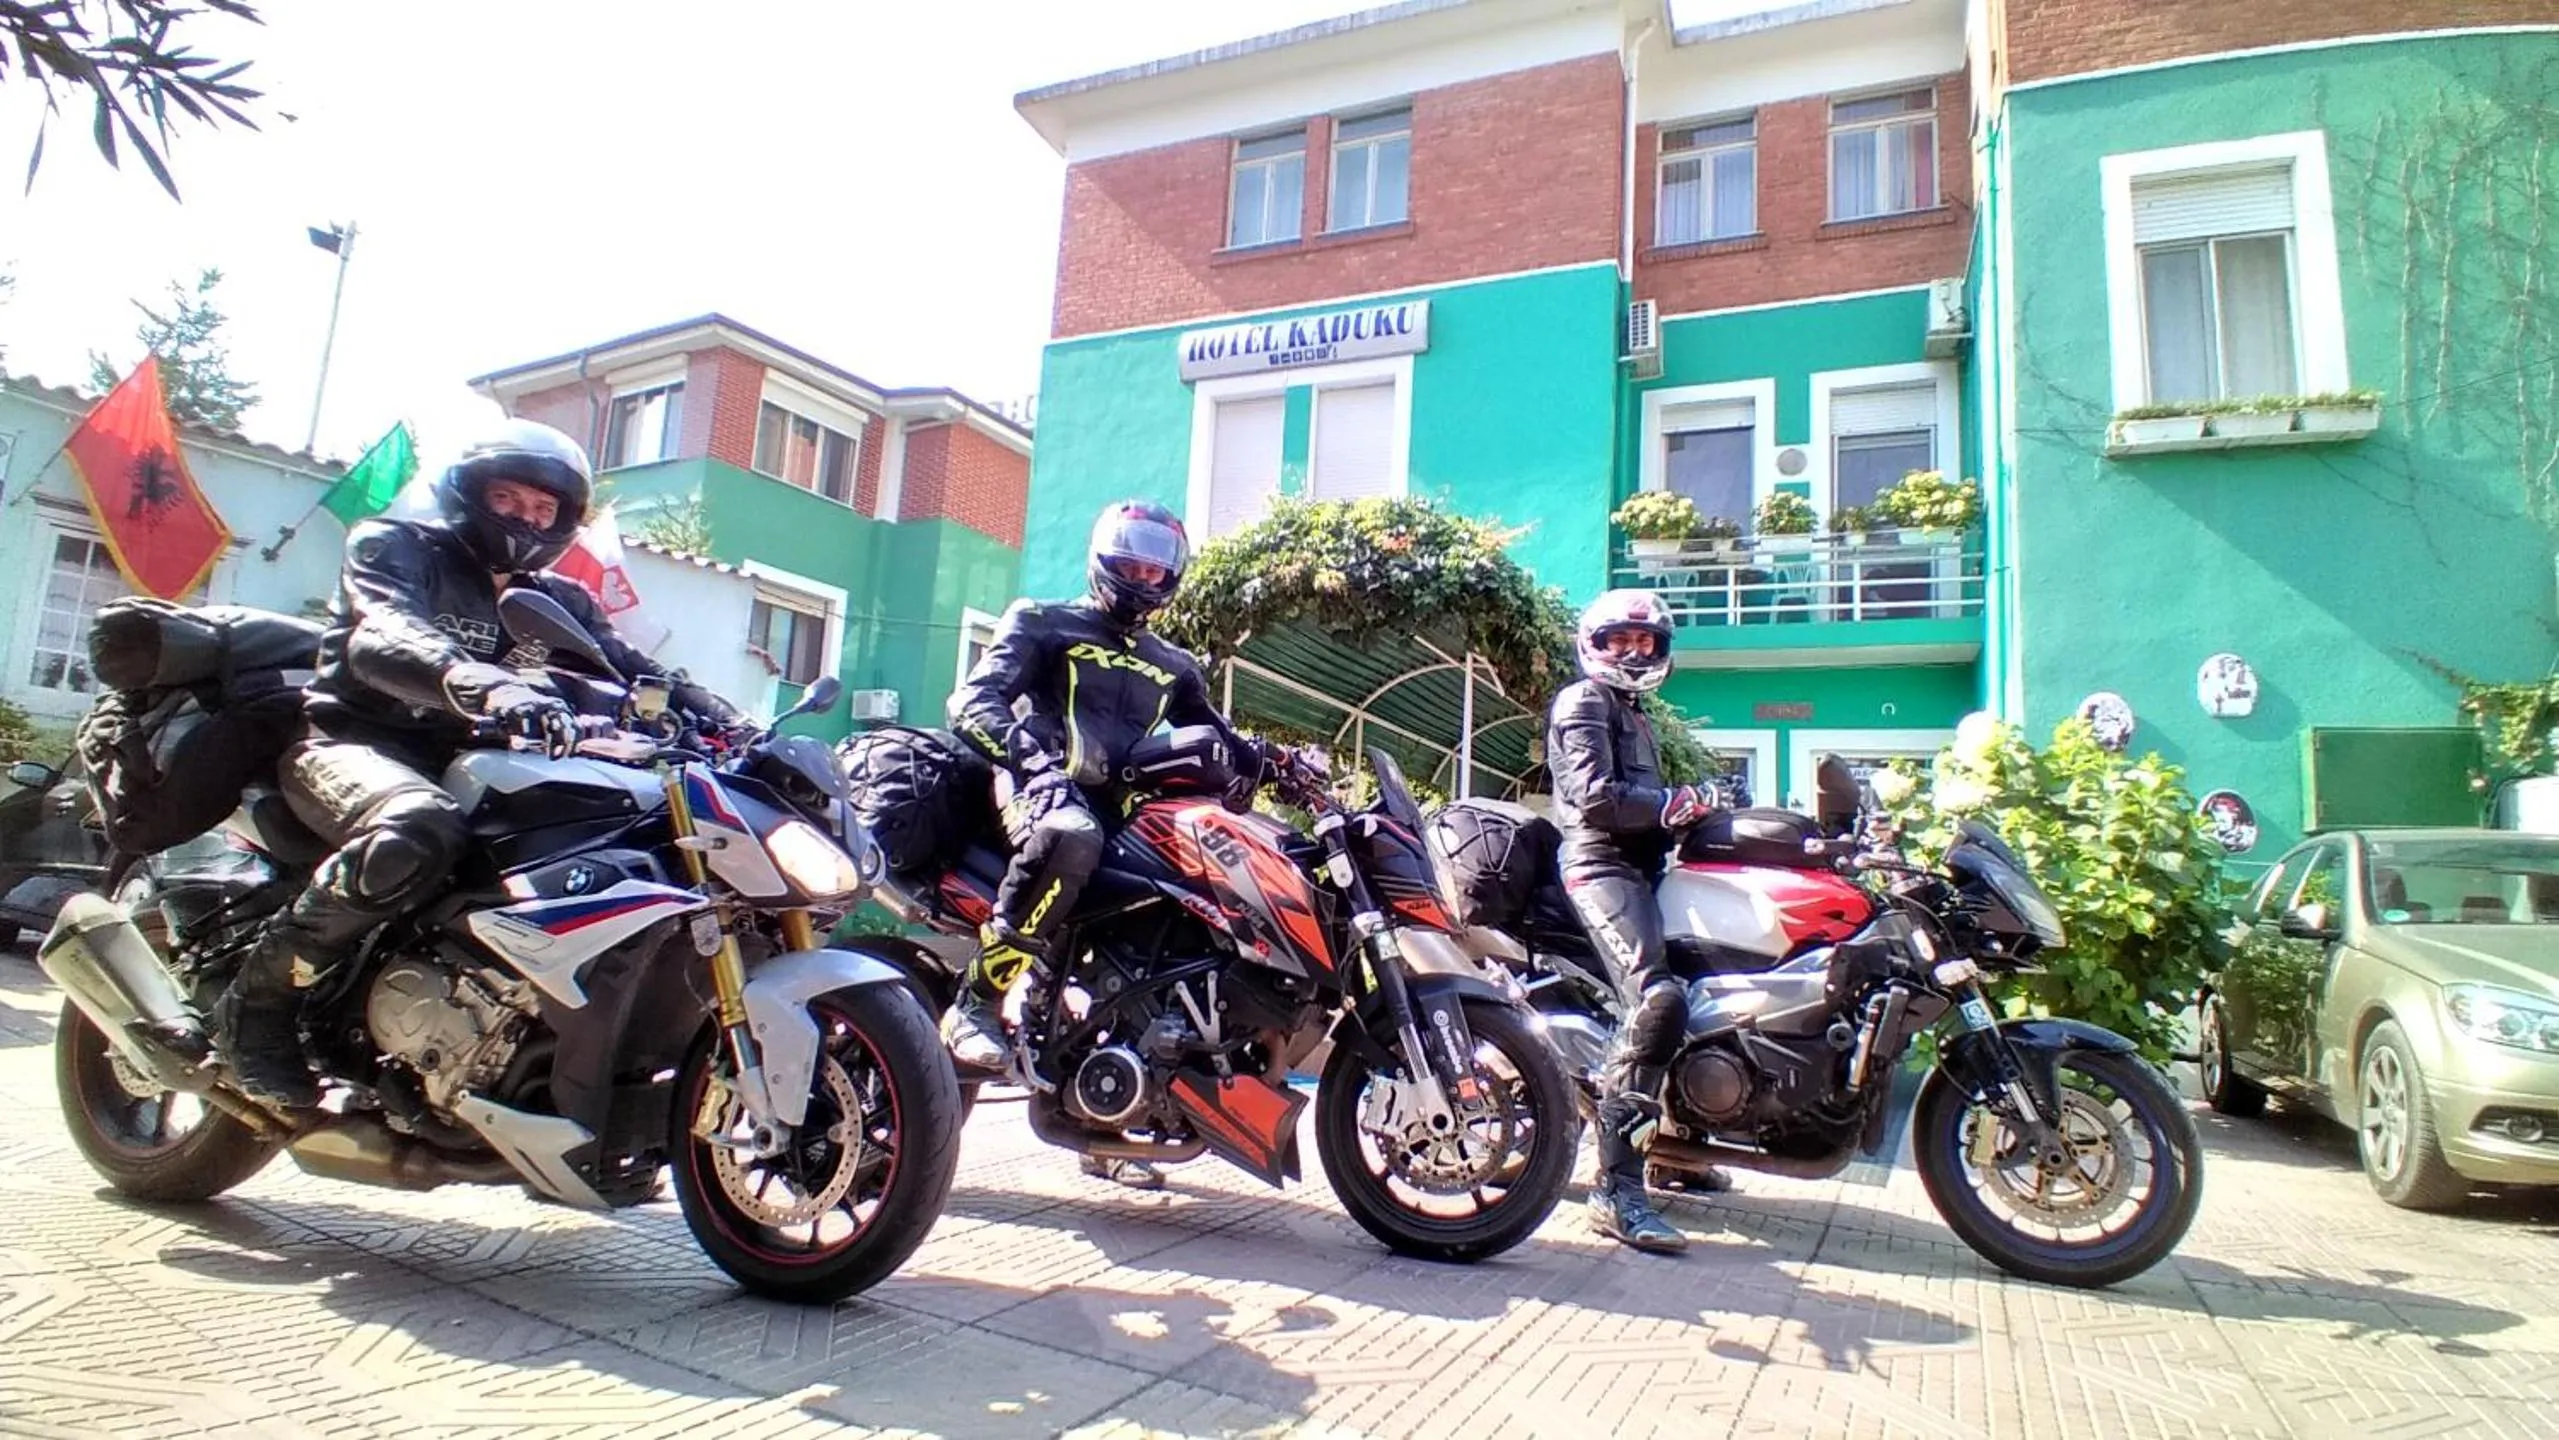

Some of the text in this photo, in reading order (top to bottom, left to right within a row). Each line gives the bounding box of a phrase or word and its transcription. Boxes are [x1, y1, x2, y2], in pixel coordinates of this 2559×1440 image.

[1187, 305, 1417, 362] HOTEL KADUKU
[1066, 642, 1176, 686] IXON
